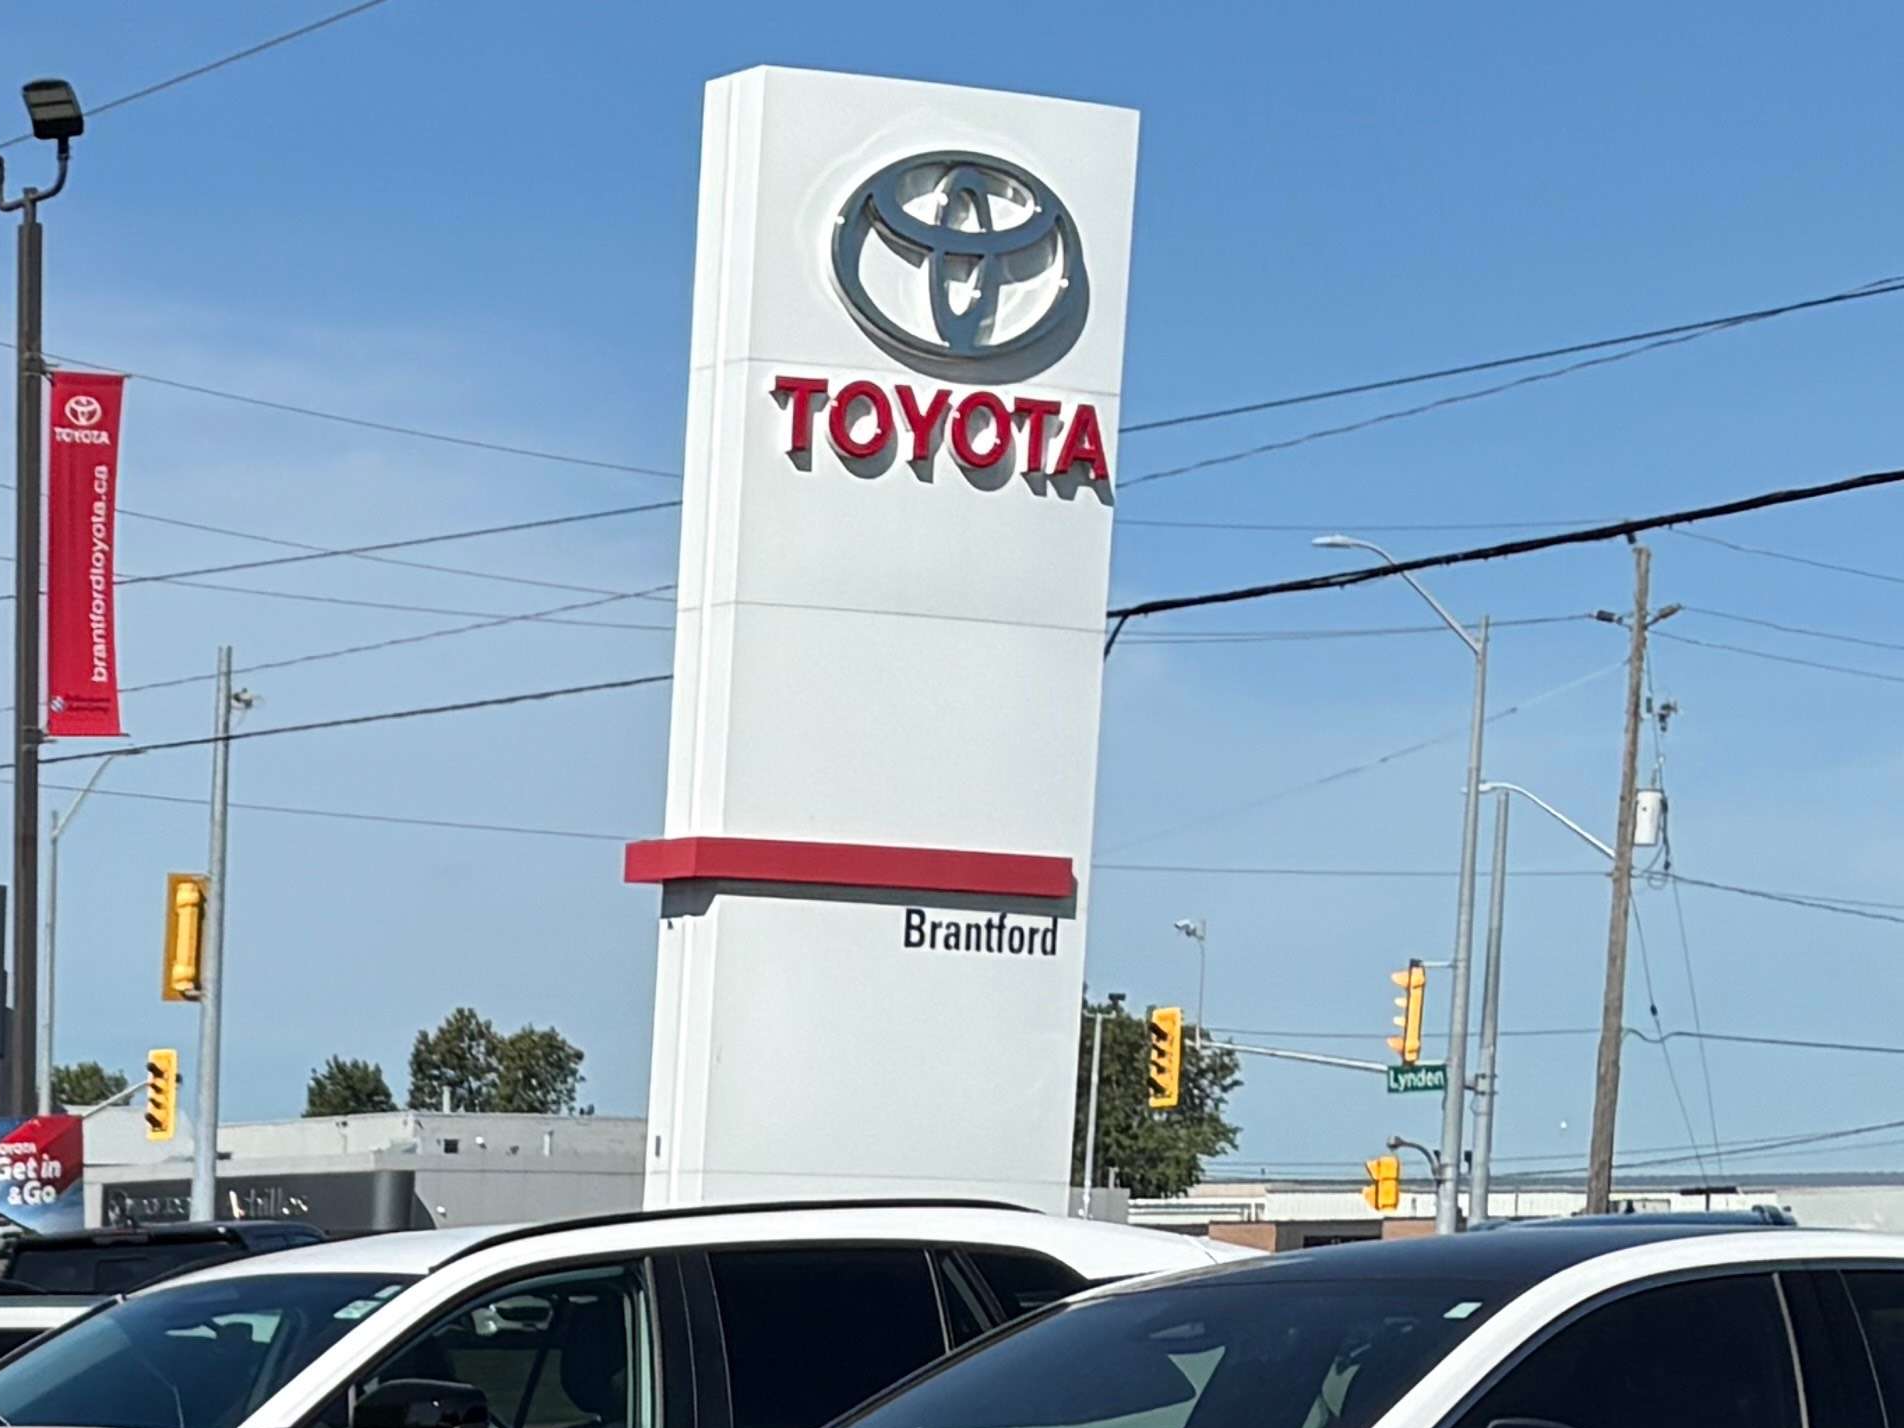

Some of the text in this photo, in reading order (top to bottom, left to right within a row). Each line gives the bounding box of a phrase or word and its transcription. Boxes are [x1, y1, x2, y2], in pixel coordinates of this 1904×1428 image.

[54, 426, 111, 446] TOYOTA
[774, 375, 1110, 482] TOYOTA
[903, 907, 1059, 956] Brantford
[1388, 1067, 1445, 1092] Lynden
[40, 1153, 62, 1179] in
